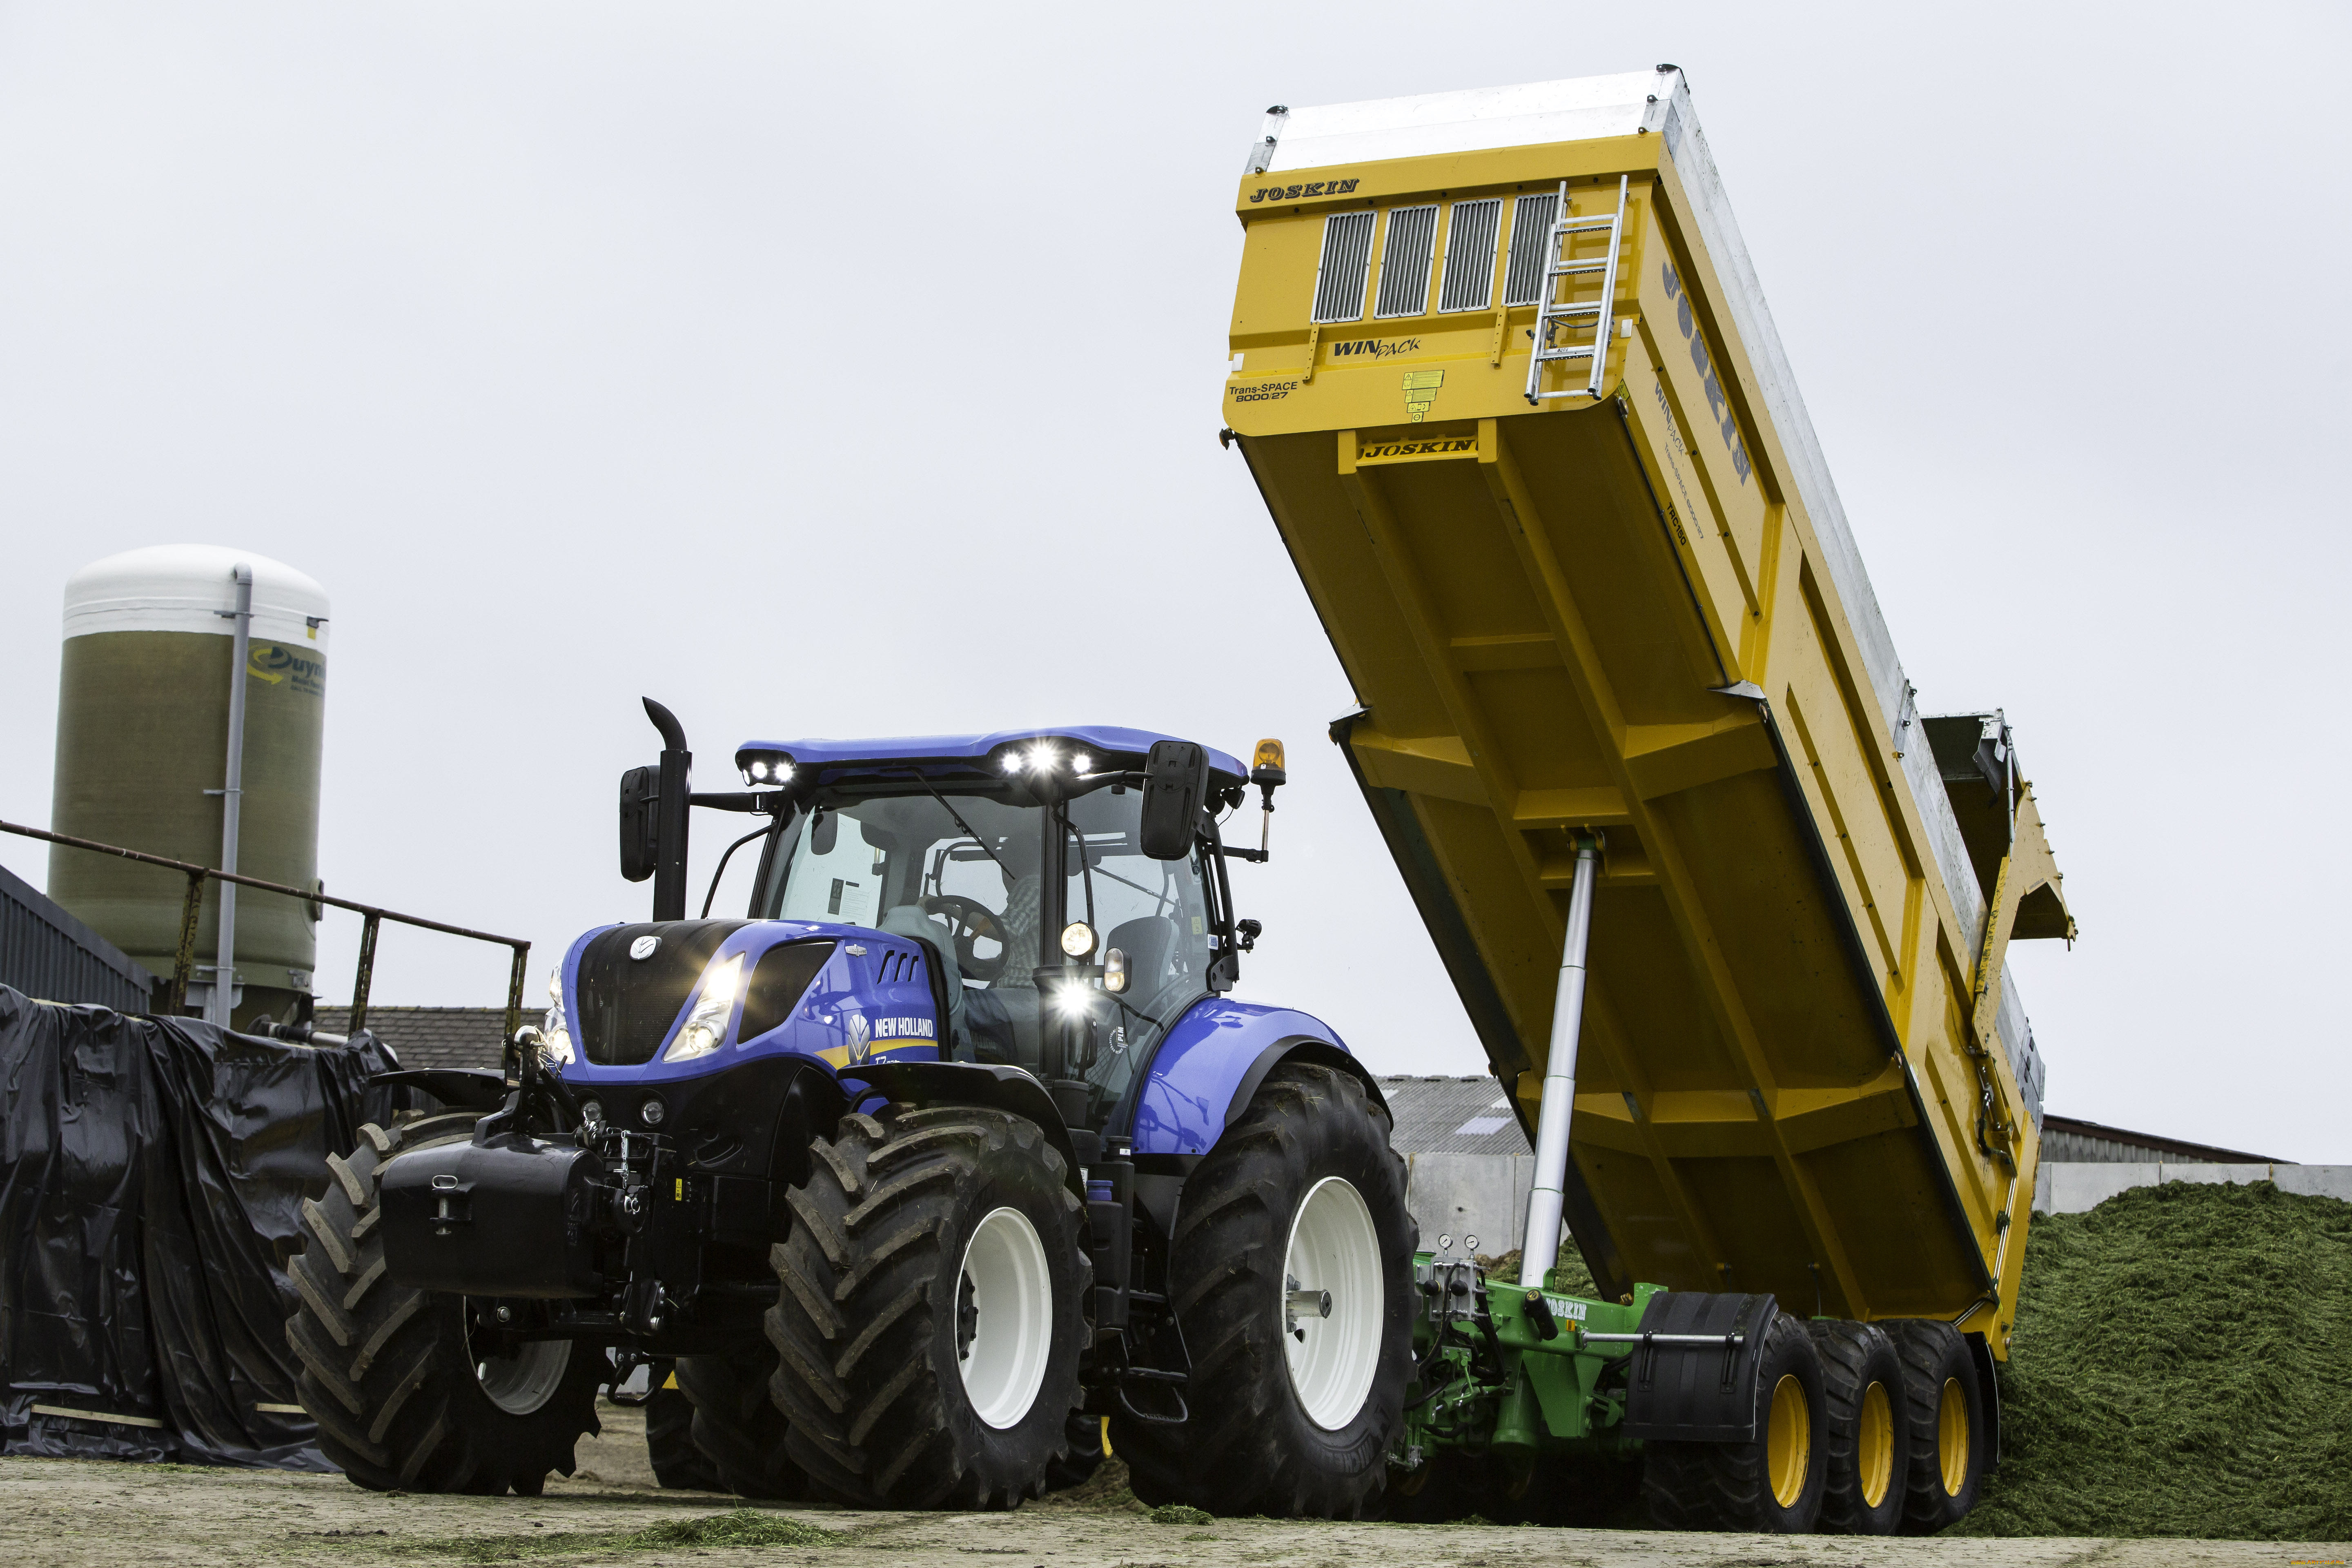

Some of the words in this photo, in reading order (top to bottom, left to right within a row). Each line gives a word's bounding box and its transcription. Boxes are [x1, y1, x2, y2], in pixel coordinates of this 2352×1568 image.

[1250, 178, 1360, 203] JOSKIN
[1662, 260, 1751, 487] JOSKIN
[1229, 382, 1298, 394] Trans-SPACE
[1236, 392, 1288, 402] 8000/27
[1365, 439, 1475, 458] JOSKIN
[1664, 442, 1688, 499] Trans-SPACE
[1667, 502, 1686, 546] TRC150
[875, 1018, 897, 1038] NEW
[898, 1017, 933, 1038] HOLLAND
